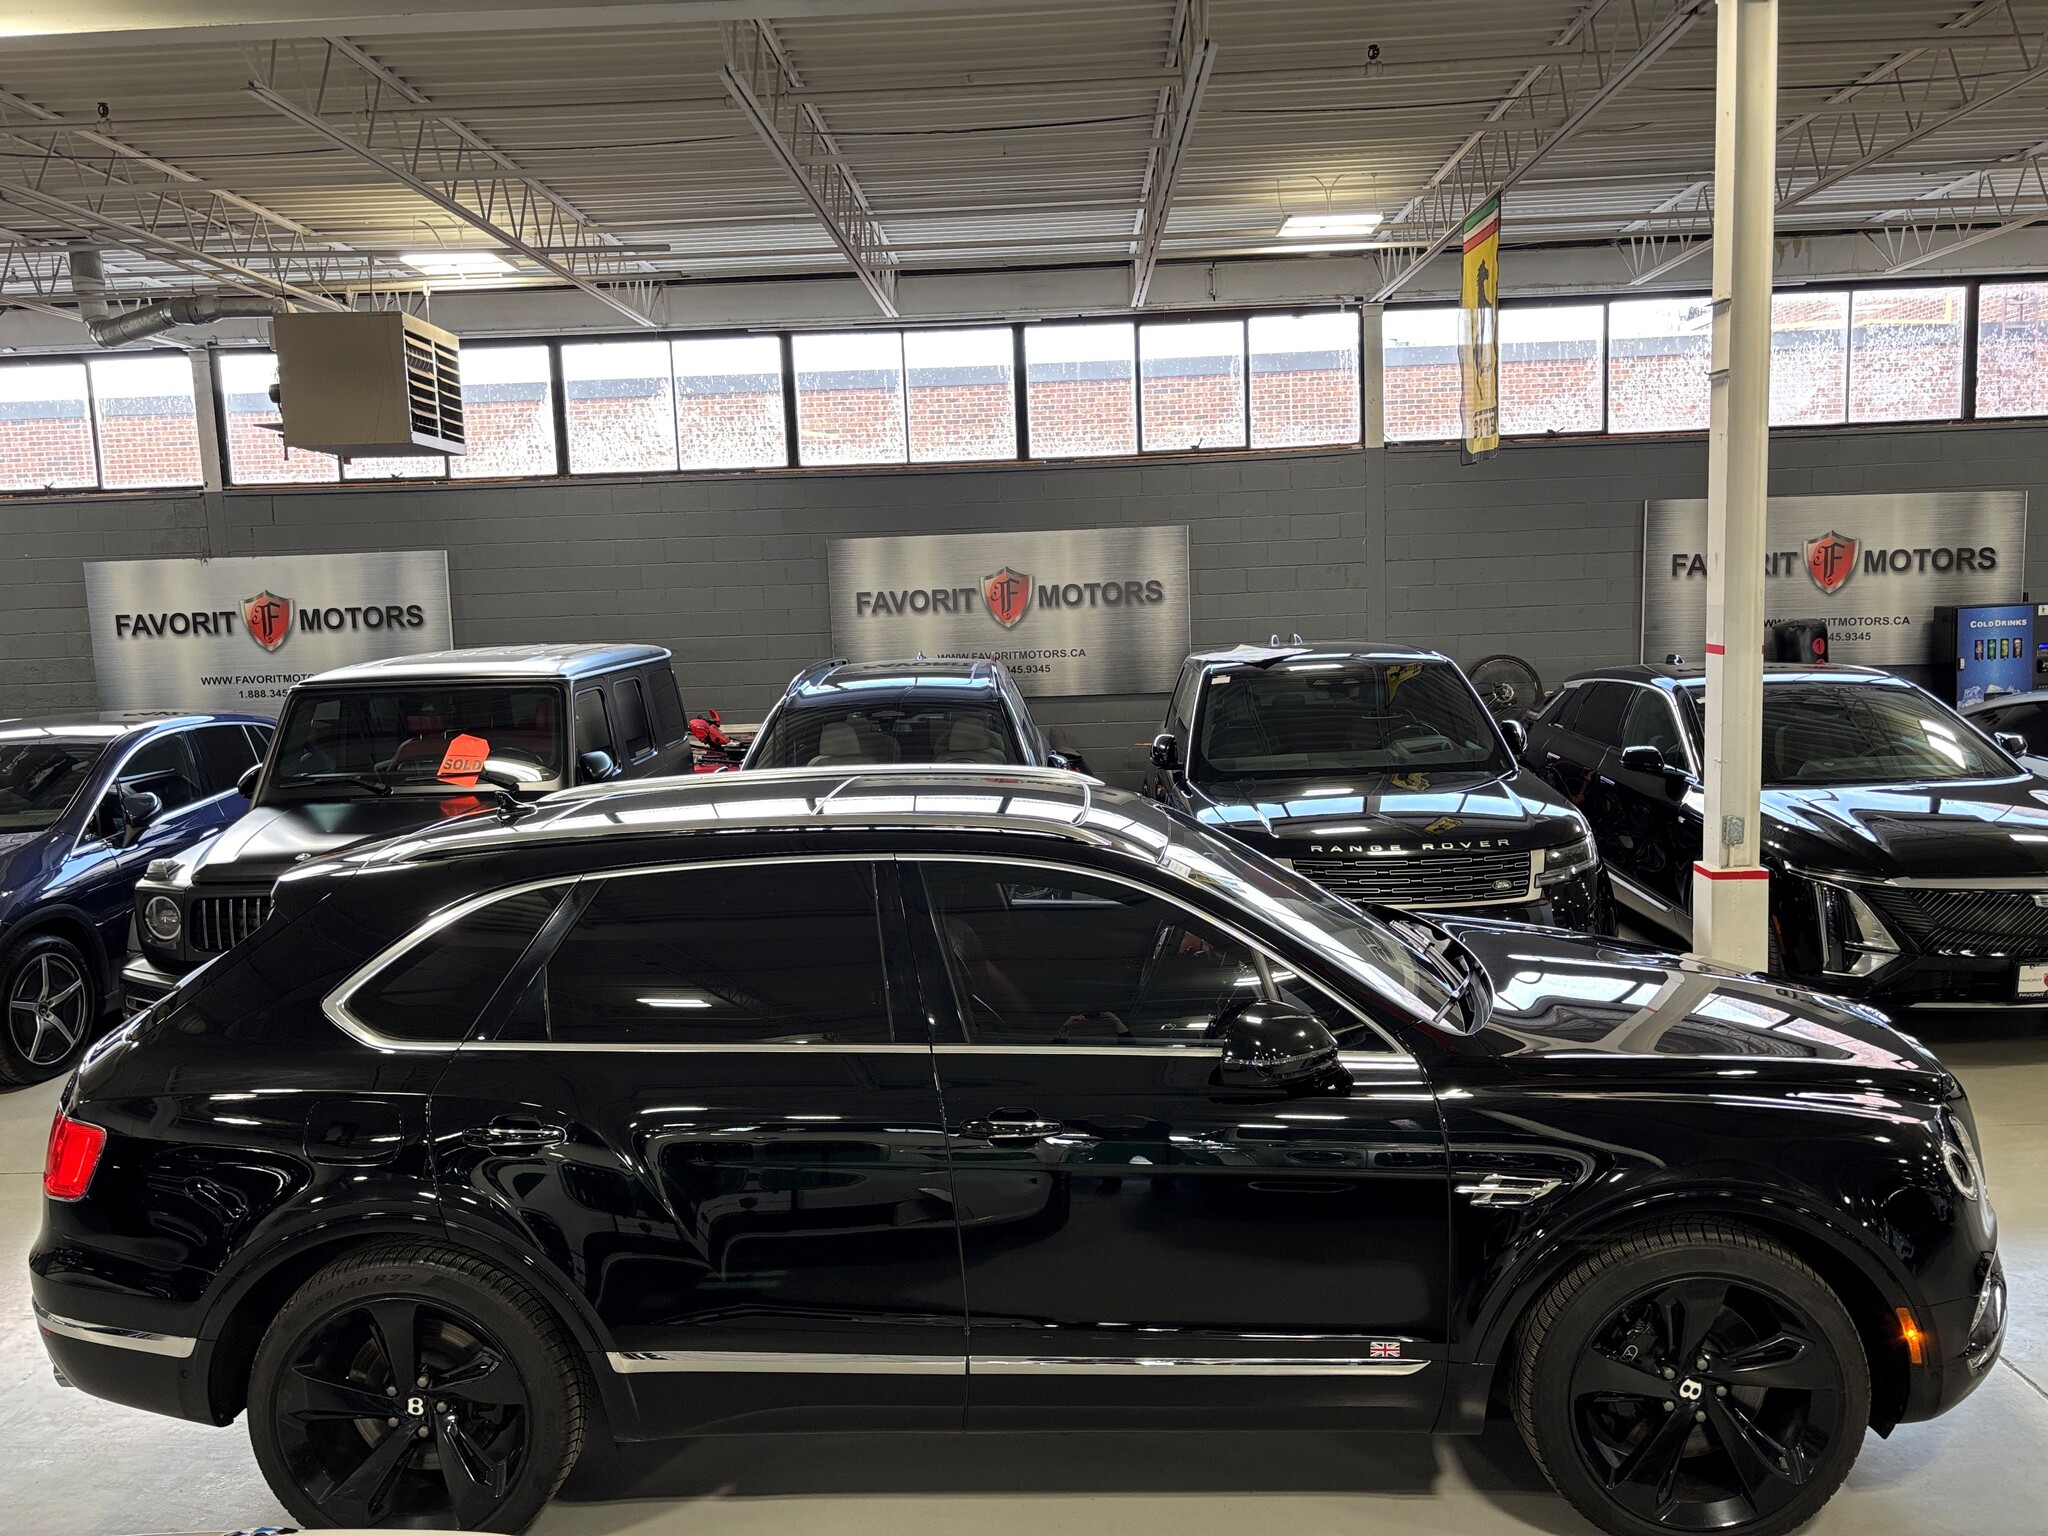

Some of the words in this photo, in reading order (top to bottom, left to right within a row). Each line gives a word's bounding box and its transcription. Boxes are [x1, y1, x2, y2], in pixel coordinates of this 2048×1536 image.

[1864, 547, 1997, 573] MOTORS
[855, 587, 976, 614] FAVORIT
[1038, 580, 1163, 608] MOTORS
[115, 610, 237, 636] FAVORIT
[299, 604, 424, 630] MOTORS
[1828, 632, 1872, 641] 45.9345
[238, 688, 288, 699] 1.888.345
[443, 758, 482, 771] SOLD
[1310, 844, 1401, 853] RANGE
[1422, 838, 1511, 851] ROVER
[1679, 1378, 1702, 1400] B
[407, 1397, 425, 1415] B
